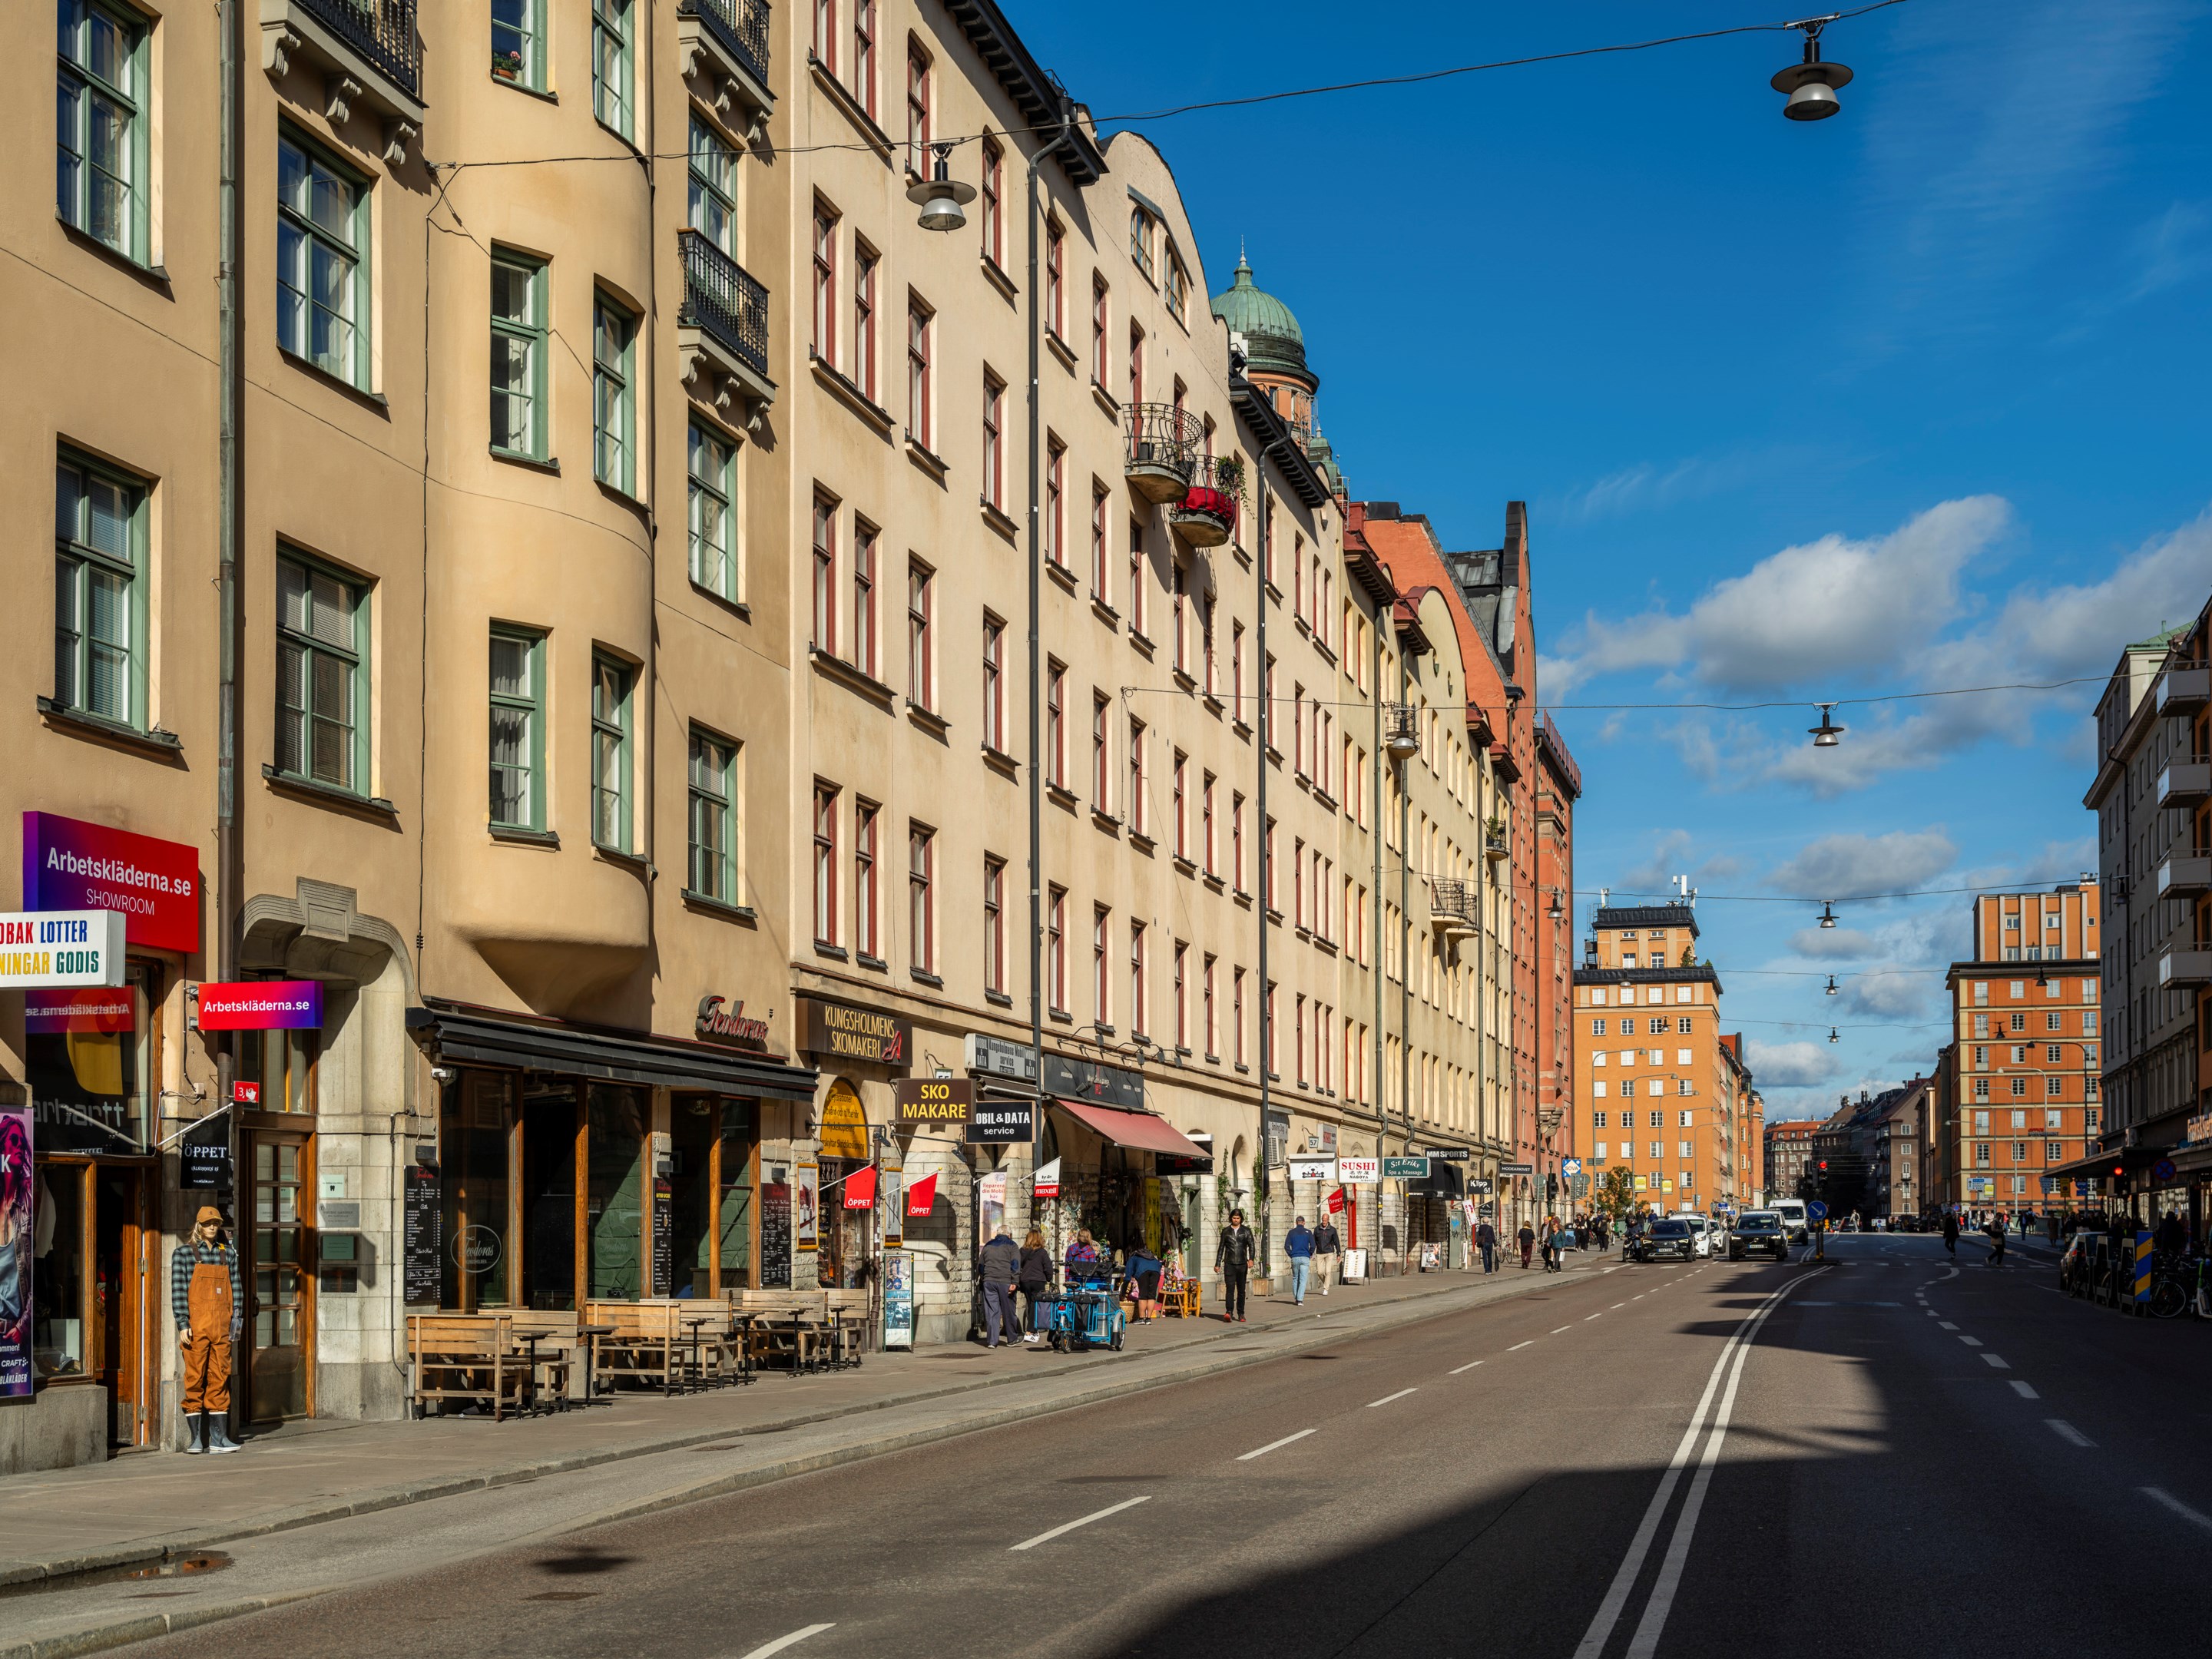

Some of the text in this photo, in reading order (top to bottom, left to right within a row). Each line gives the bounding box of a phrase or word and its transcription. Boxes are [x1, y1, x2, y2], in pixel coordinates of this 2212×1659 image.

[47, 847, 191, 896] Arbetskläderna.se
[86, 888, 154, 916] SHOWROOM
[40, 920, 88, 943] LOTTER
[56, 950, 99, 974] GODIS
[204, 1000, 310, 1012] Arbetskläderna.se
[696, 995, 768, 1041] Teodoras
[825, 1005, 895, 1039] KUNGSHOLMENS
[832, 1031, 880, 1058] SKOMAKERI
[920, 1084, 950, 1100] SKO
[33, 1098, 124, 1128] arhartt
[902, 1104, 967, 1118] MAKARE
[976, 1111, 1031, 1124] OBIL&DATA
[984, 1127, 1015, 1135] service
[184, 1143, 227, 1158] ÖPPET
[1341, 1162, 1376, 1171] SUSHI
[1402, 1159, 1420, 1168] Eriks
[1035, 1187, 1057, 1195] maxell
[847, 1197, 871, 1207] ÖPPET
[911, 1206, 930, 1214] ÖPPET
[464, 1236, 494, 1257] Teodoras
[1, 1359, 23, 1367] CRAFT
